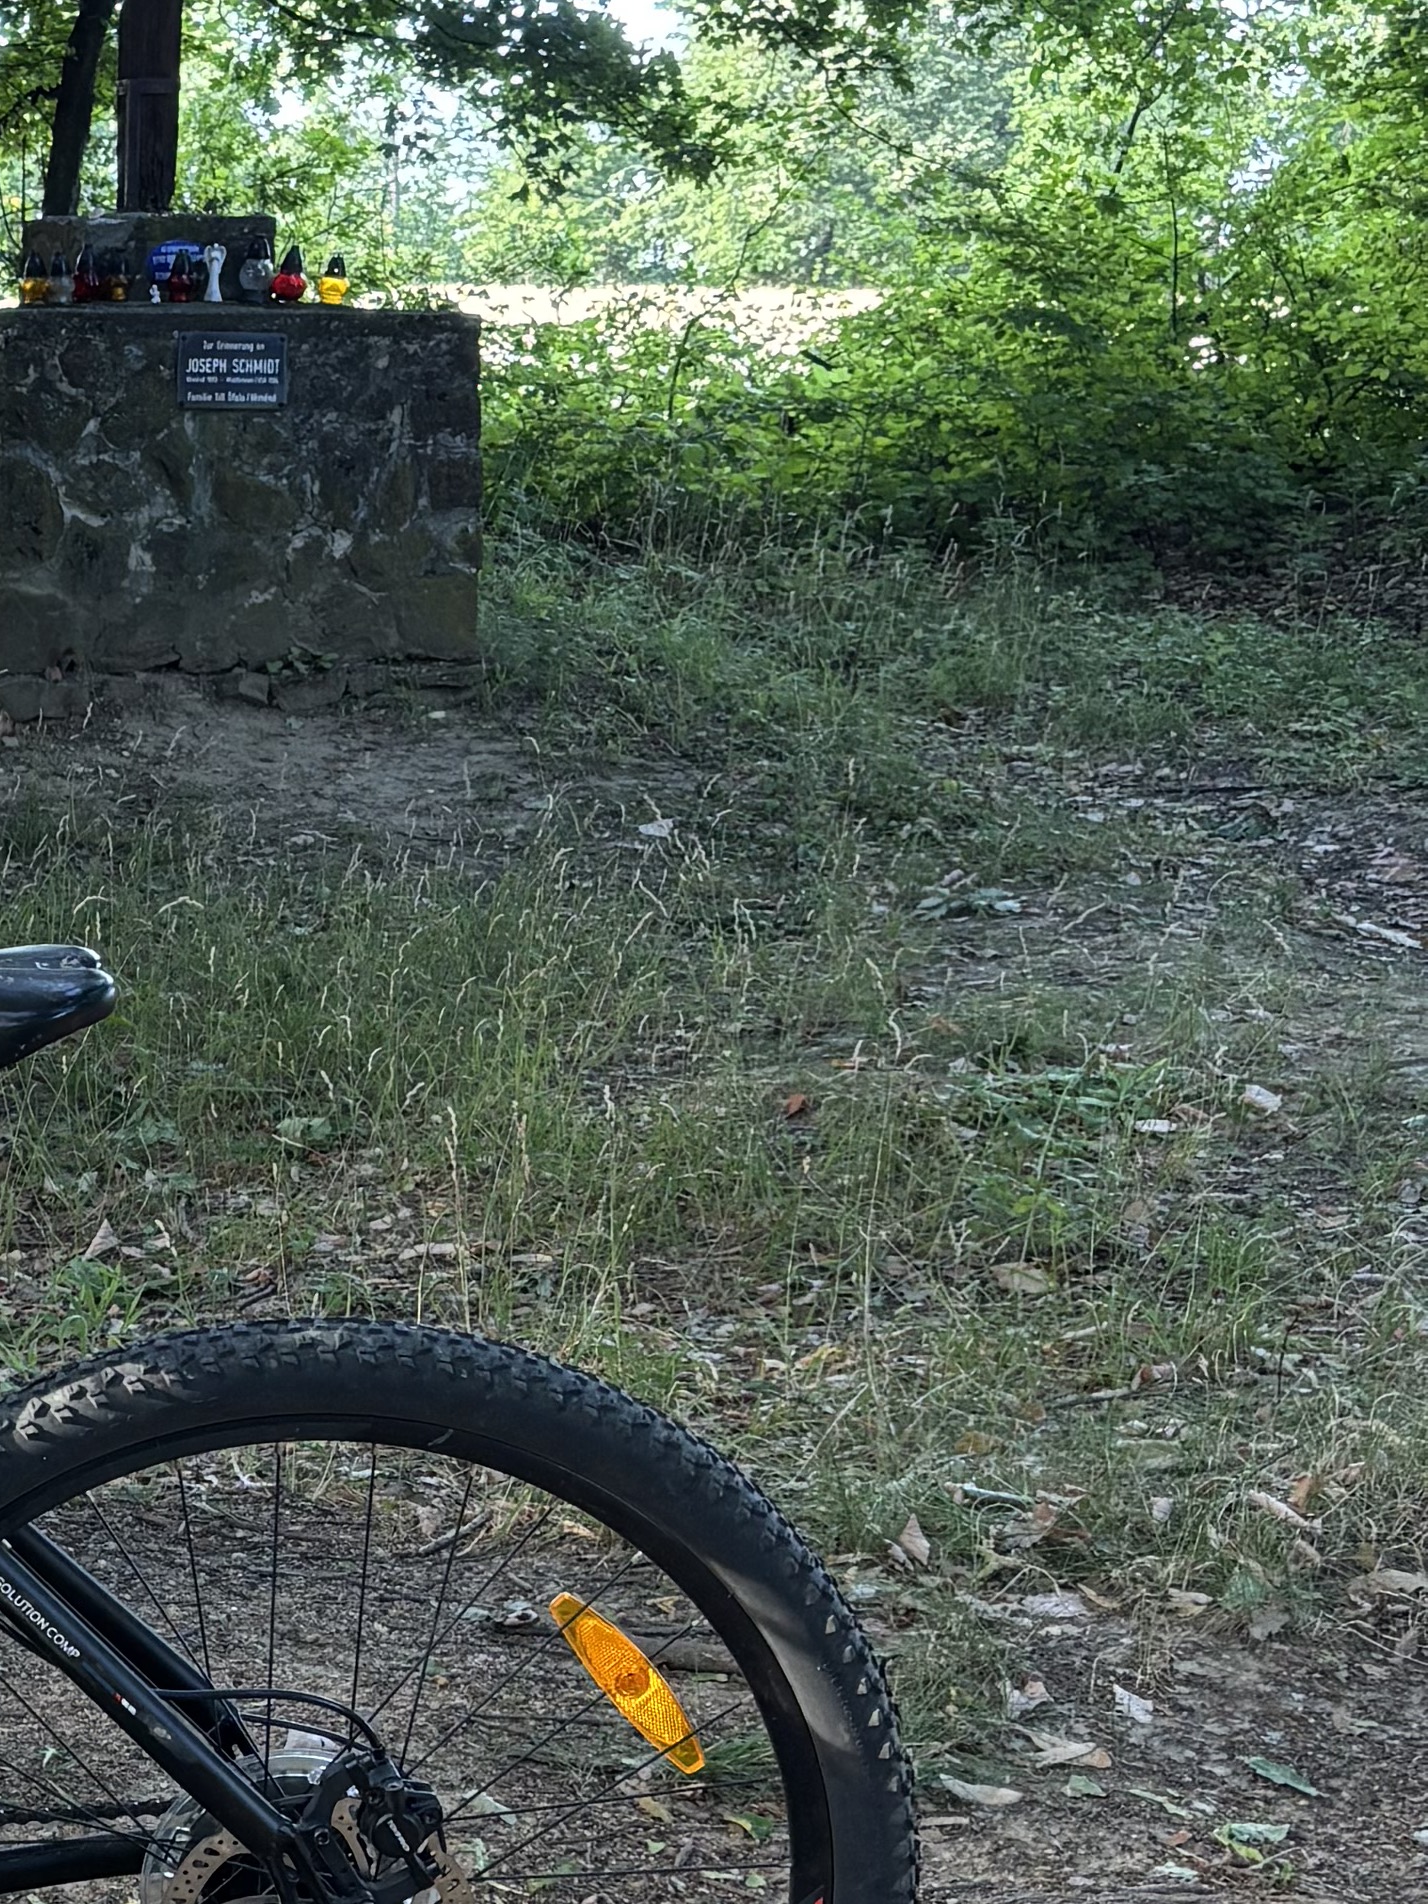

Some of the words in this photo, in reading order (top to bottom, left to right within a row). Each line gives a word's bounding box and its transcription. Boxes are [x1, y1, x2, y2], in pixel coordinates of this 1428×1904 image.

[186, 358, 227, 373] JOSEPH
[232, 358, 280, 374] SCHMIDT
[46, 1627, 81, 1659] COMP
